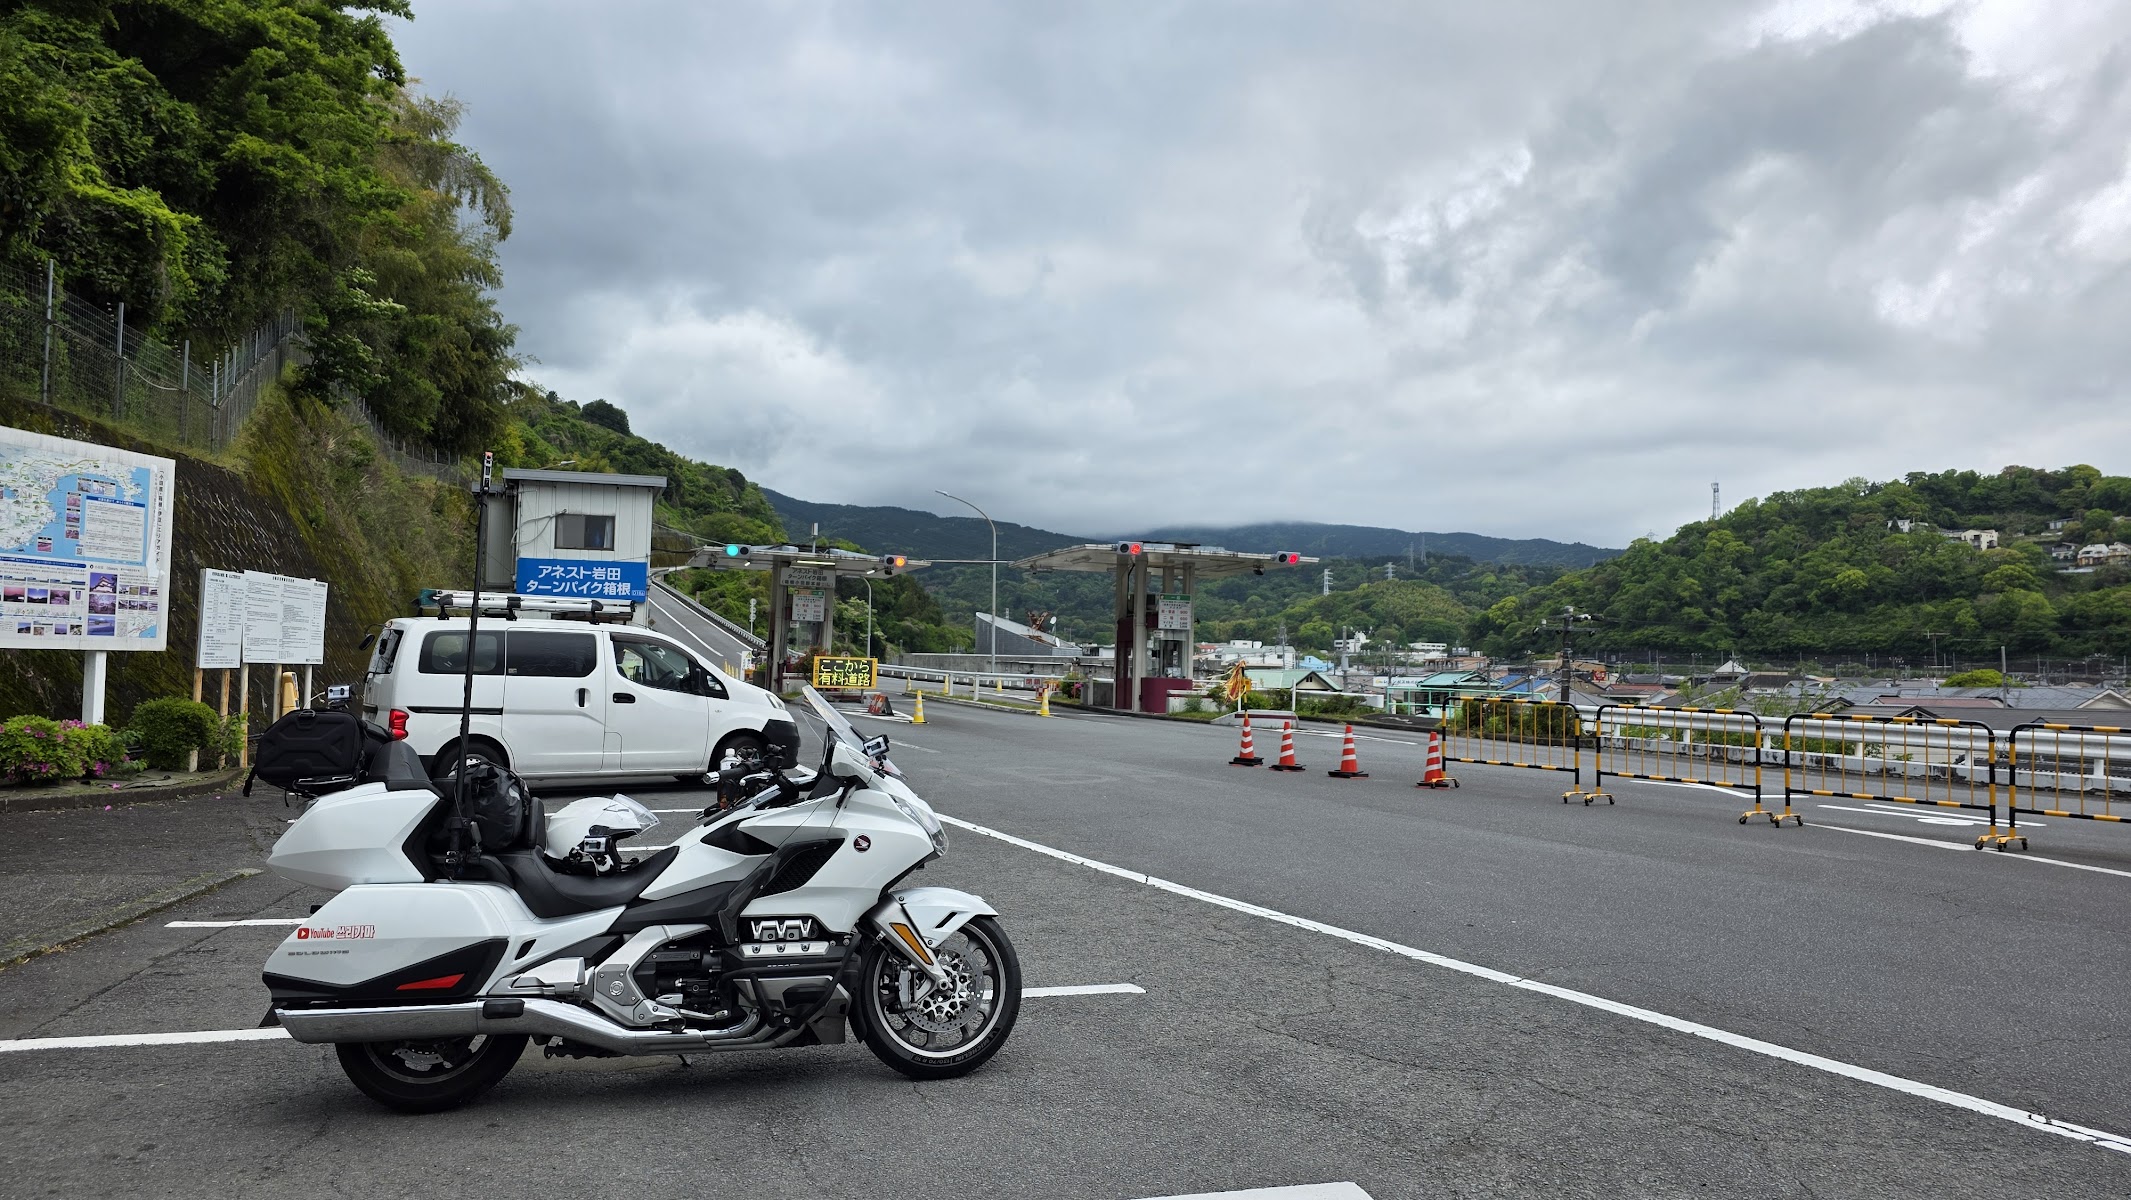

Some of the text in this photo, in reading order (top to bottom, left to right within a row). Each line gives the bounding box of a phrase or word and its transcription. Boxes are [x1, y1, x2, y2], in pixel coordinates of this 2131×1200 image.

[538, 565, 621, 581] アネスト岩田
[526, 579, 631, 596] ターンパイク箱根
[820, 659, 870, 673] ここから
[819, 672, 871, 687] 有料道路
[310, 927, 335, 939] YouTube
[955, 1037, 990, 1062] MICHELIN
